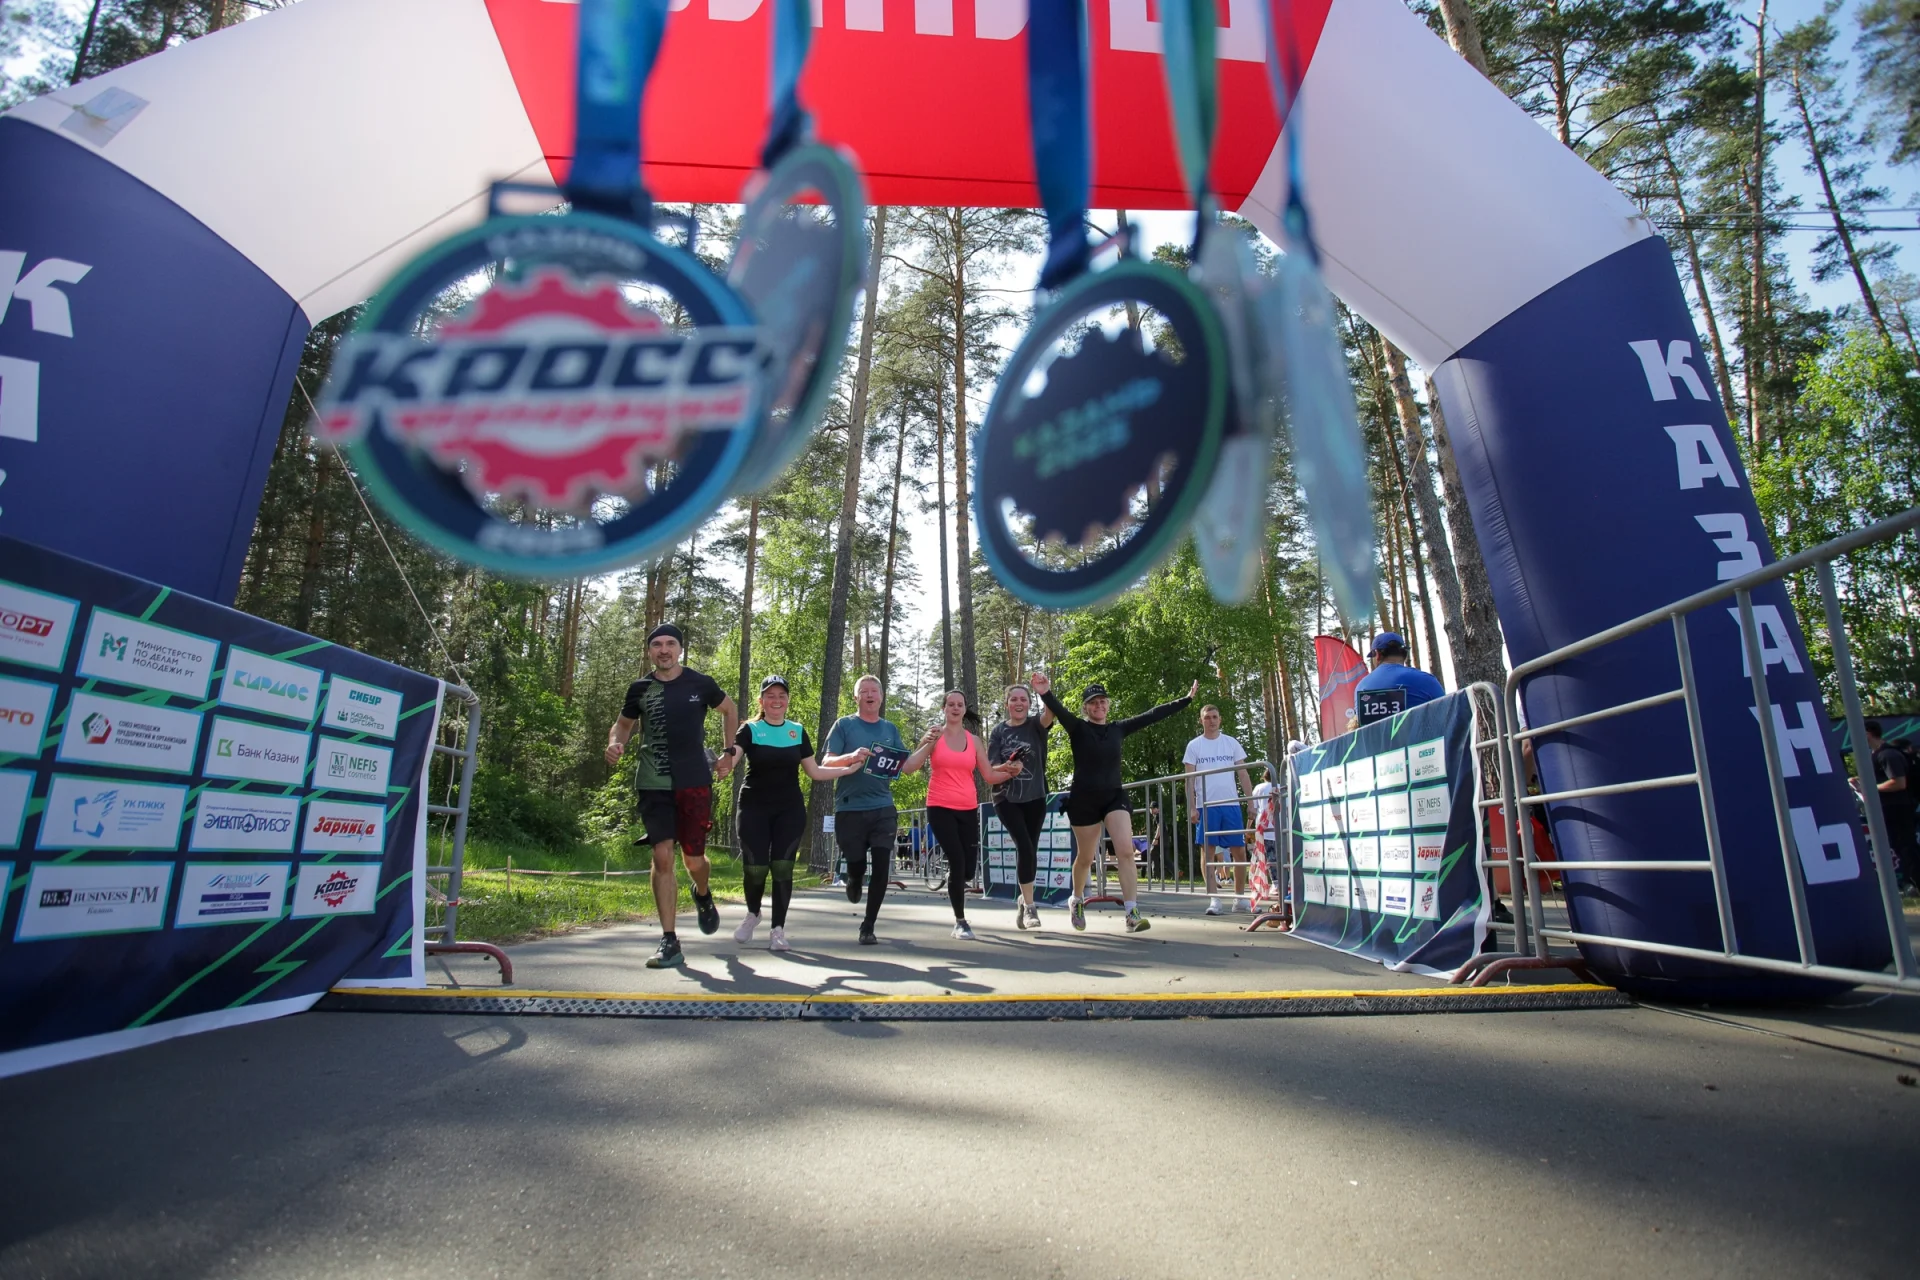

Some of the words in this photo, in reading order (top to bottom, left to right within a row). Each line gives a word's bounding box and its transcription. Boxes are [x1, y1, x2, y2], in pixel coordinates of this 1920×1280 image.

[339, 341, 758, 400] КРОСС
[1628, 339, 1860, 885] КАЗАНЬ
[0, 611, 51, 635] ОРТ
[134, 649, 148, 659] ПО
[149, 652, 179, 666] ДЕЛАМ
[136, 640, 203, 663] МИНИСТЕРСТВО
[132, 658, 182, 676] МОЛОДЕЖИ
[184, 670, 195, 678] РТ
[348, 689, 382, 706] СИБУР
[350, 711, 375, 722] КАЗАНЬ
[1364, 701, 1401, 716] 125.3
[118, 720, 132, 729] СОЮЗ
[133, 722, 161, 732] МОЛОДЕЖИ
[237, 744, 261, 758] Банк
[263, 748, 300, 764] Казани
[348, 756, 378, 772] NEFIS
[877, 756, 900, 771] 87.1
[348, 770, 377, 780] cosmetics
[123, 799, 136, 808] УК
[138, 800, 166, 810] ПЖКХ
[313, 816, 376, 838] Зарница
[314, 878, 358, 895] КРОСС
[42, 890, 70, 905] 93.5
[73, 891, 128, 904] BUSINESS
[129, 886, 160, 904] FM
